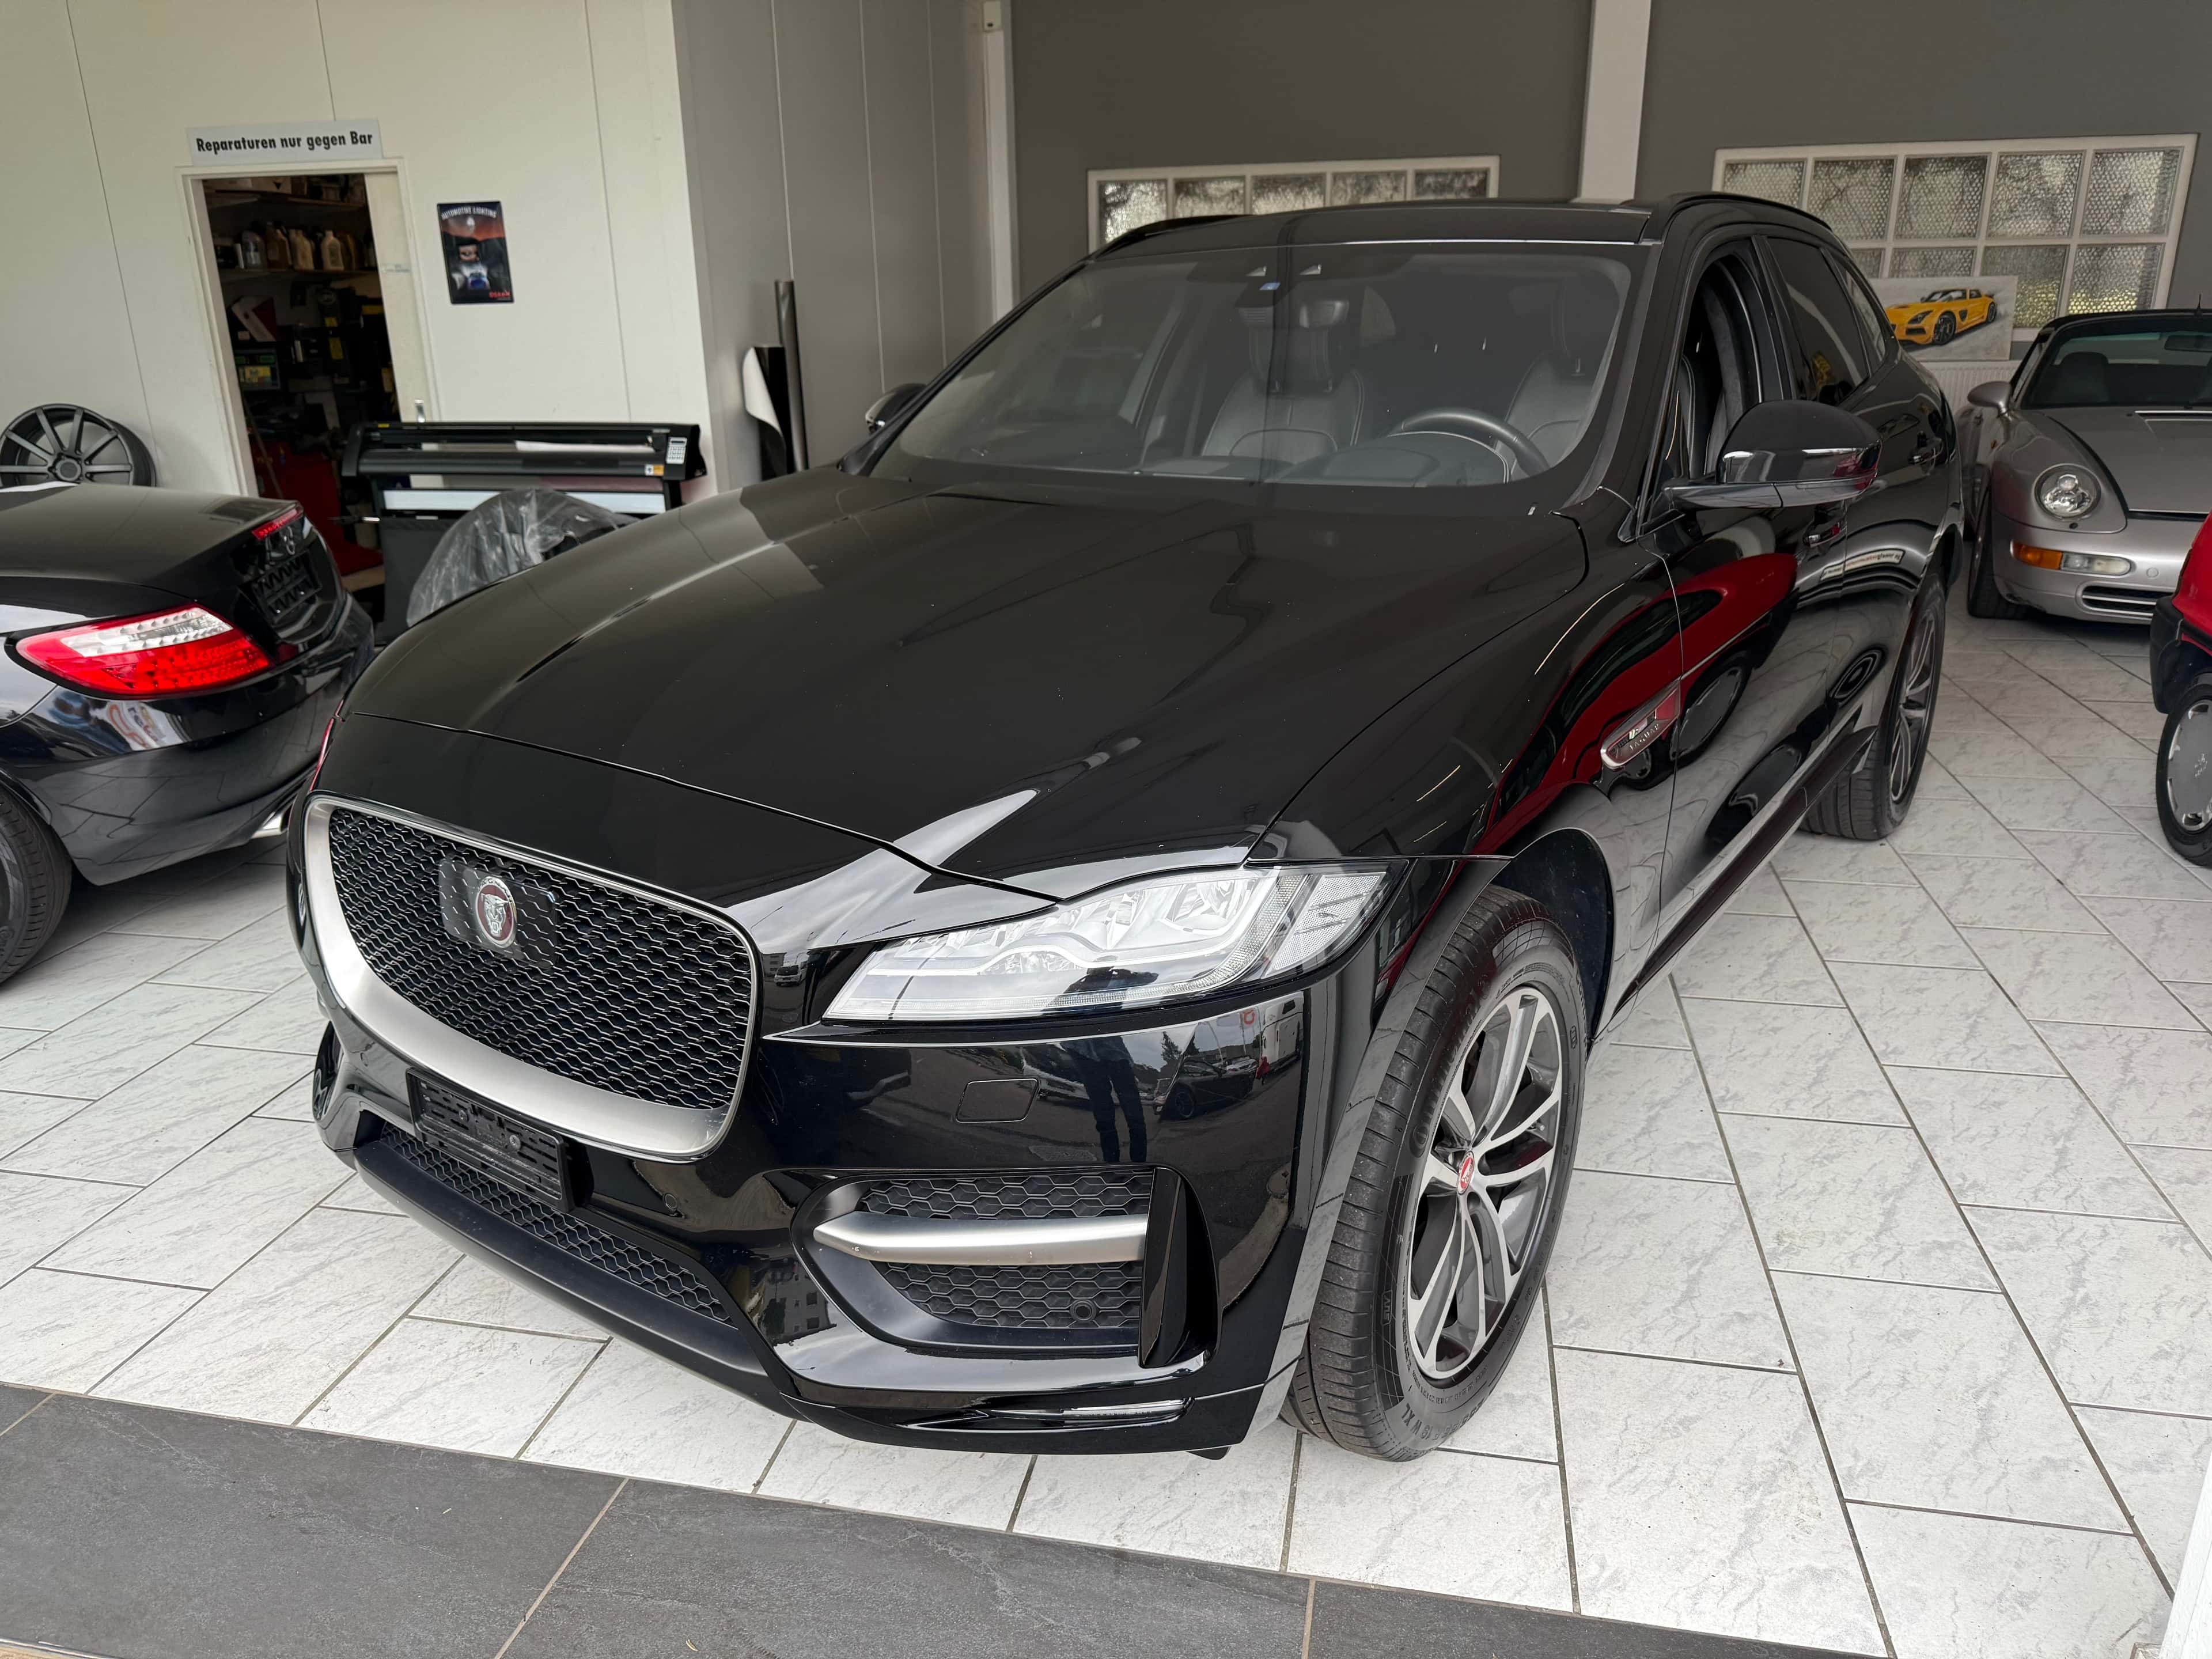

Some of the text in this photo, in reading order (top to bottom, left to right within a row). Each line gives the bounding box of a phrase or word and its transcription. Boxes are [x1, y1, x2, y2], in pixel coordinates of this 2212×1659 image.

[196, 130, 373, 154] Reparaturen nur gegen Bar
